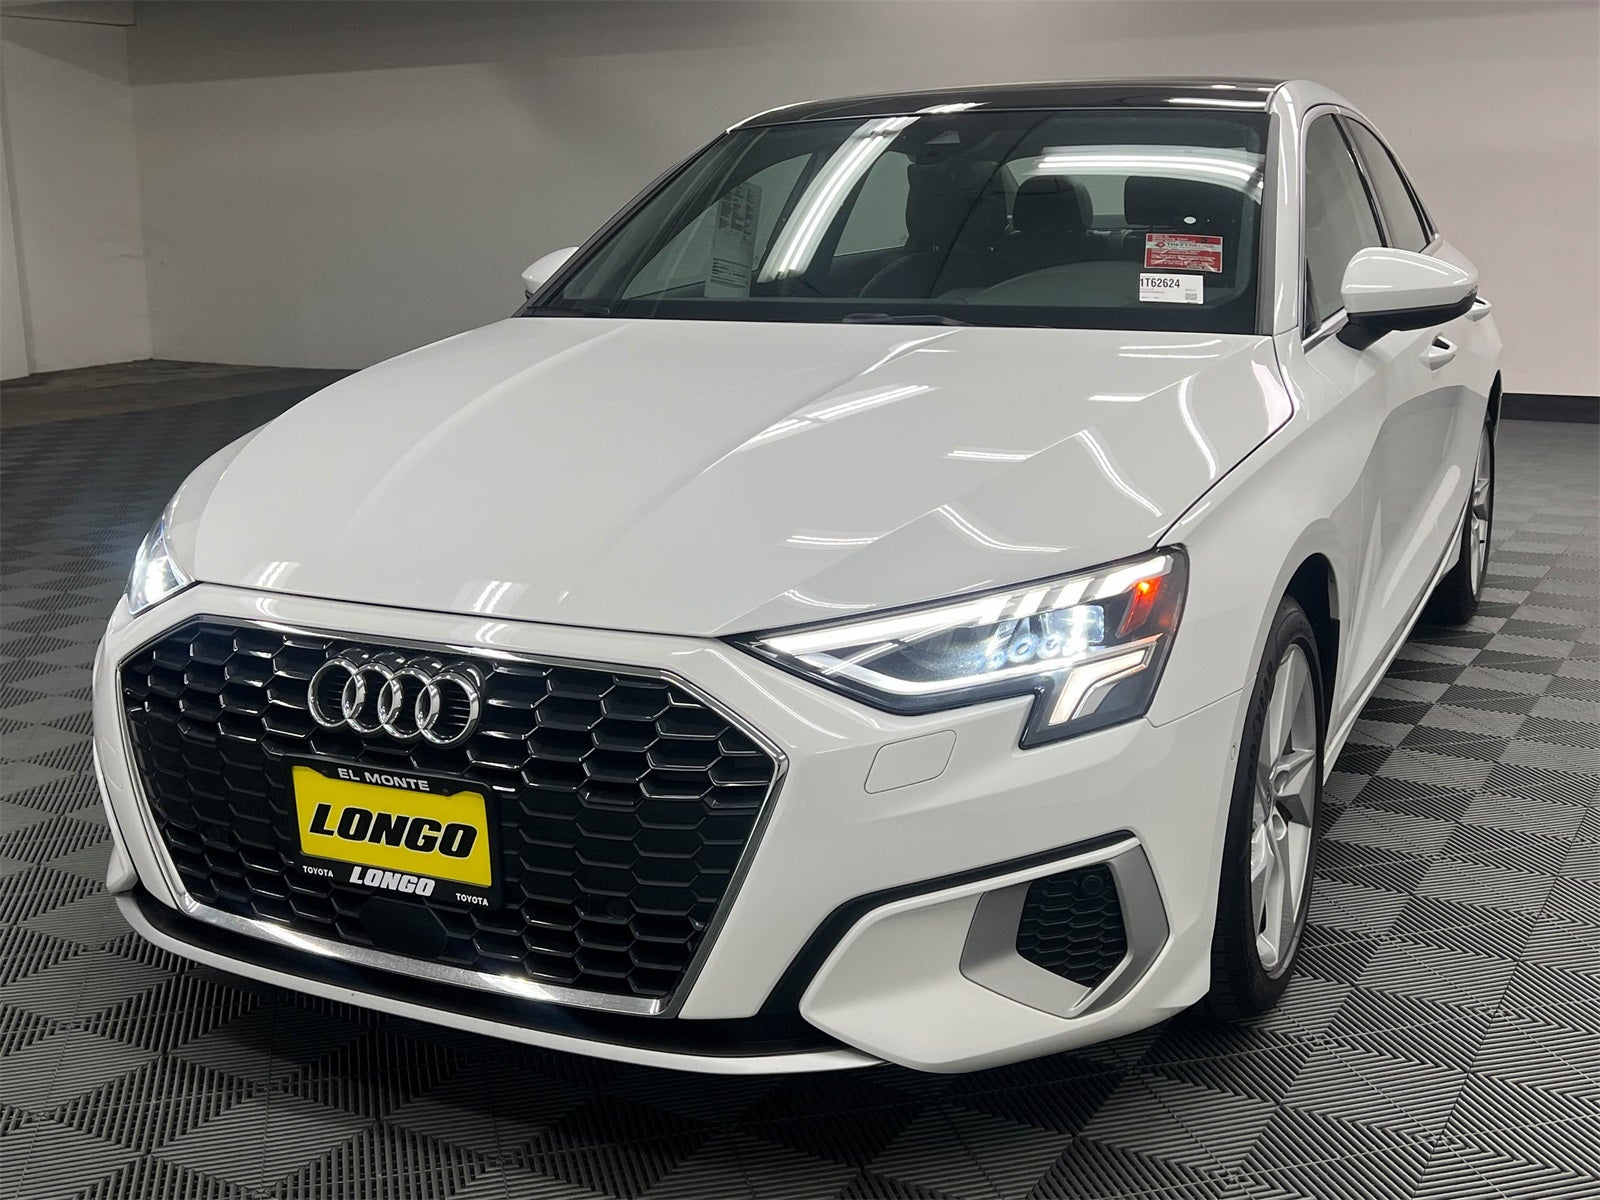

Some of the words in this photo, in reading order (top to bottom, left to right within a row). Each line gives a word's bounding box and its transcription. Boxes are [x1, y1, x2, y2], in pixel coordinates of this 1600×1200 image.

[1140, 277, 1180, 288] 1T62624
[337, 767, 360, 781] EL
[364, 771, 430, 791] MONTE
[308, 802, 478, 859] LONGO
[302, 865, 334, 878] TOYOTA
[349, 866, 436, 897] LONGO
[455, 892, 489, 907] TOYOTA
